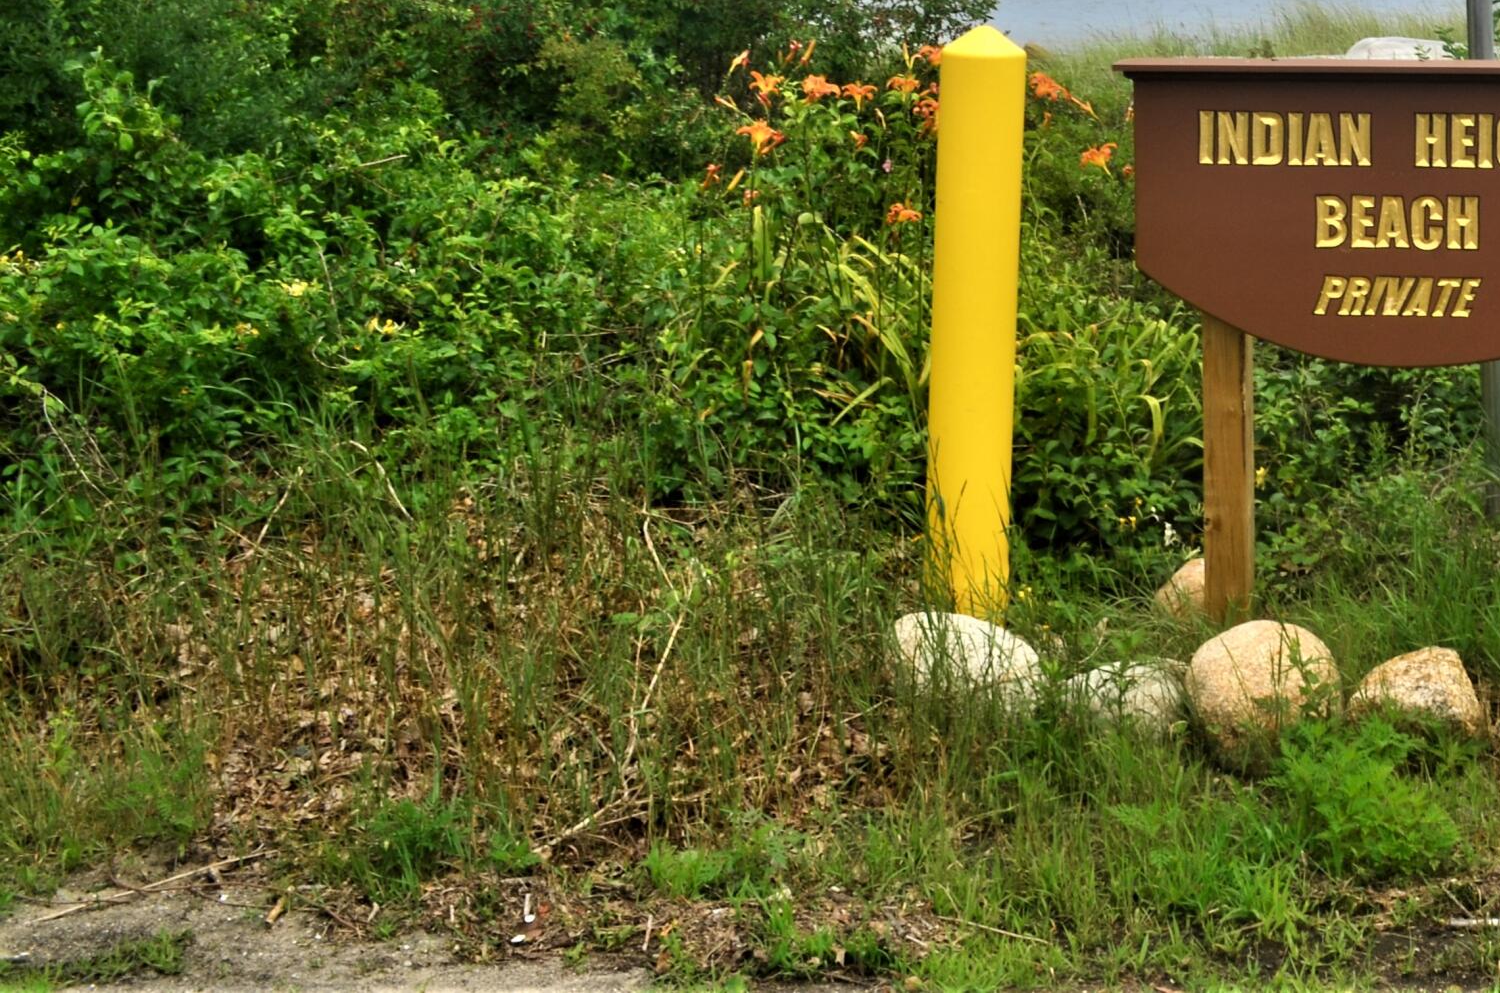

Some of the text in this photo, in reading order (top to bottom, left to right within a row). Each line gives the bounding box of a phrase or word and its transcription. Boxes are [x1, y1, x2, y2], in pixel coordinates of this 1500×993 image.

[1199, 110, 1372, 166] INDIAN
[1314, 195, 1480, 251] BEACH
[1313, 277, 1481, 319] PRIVATE
